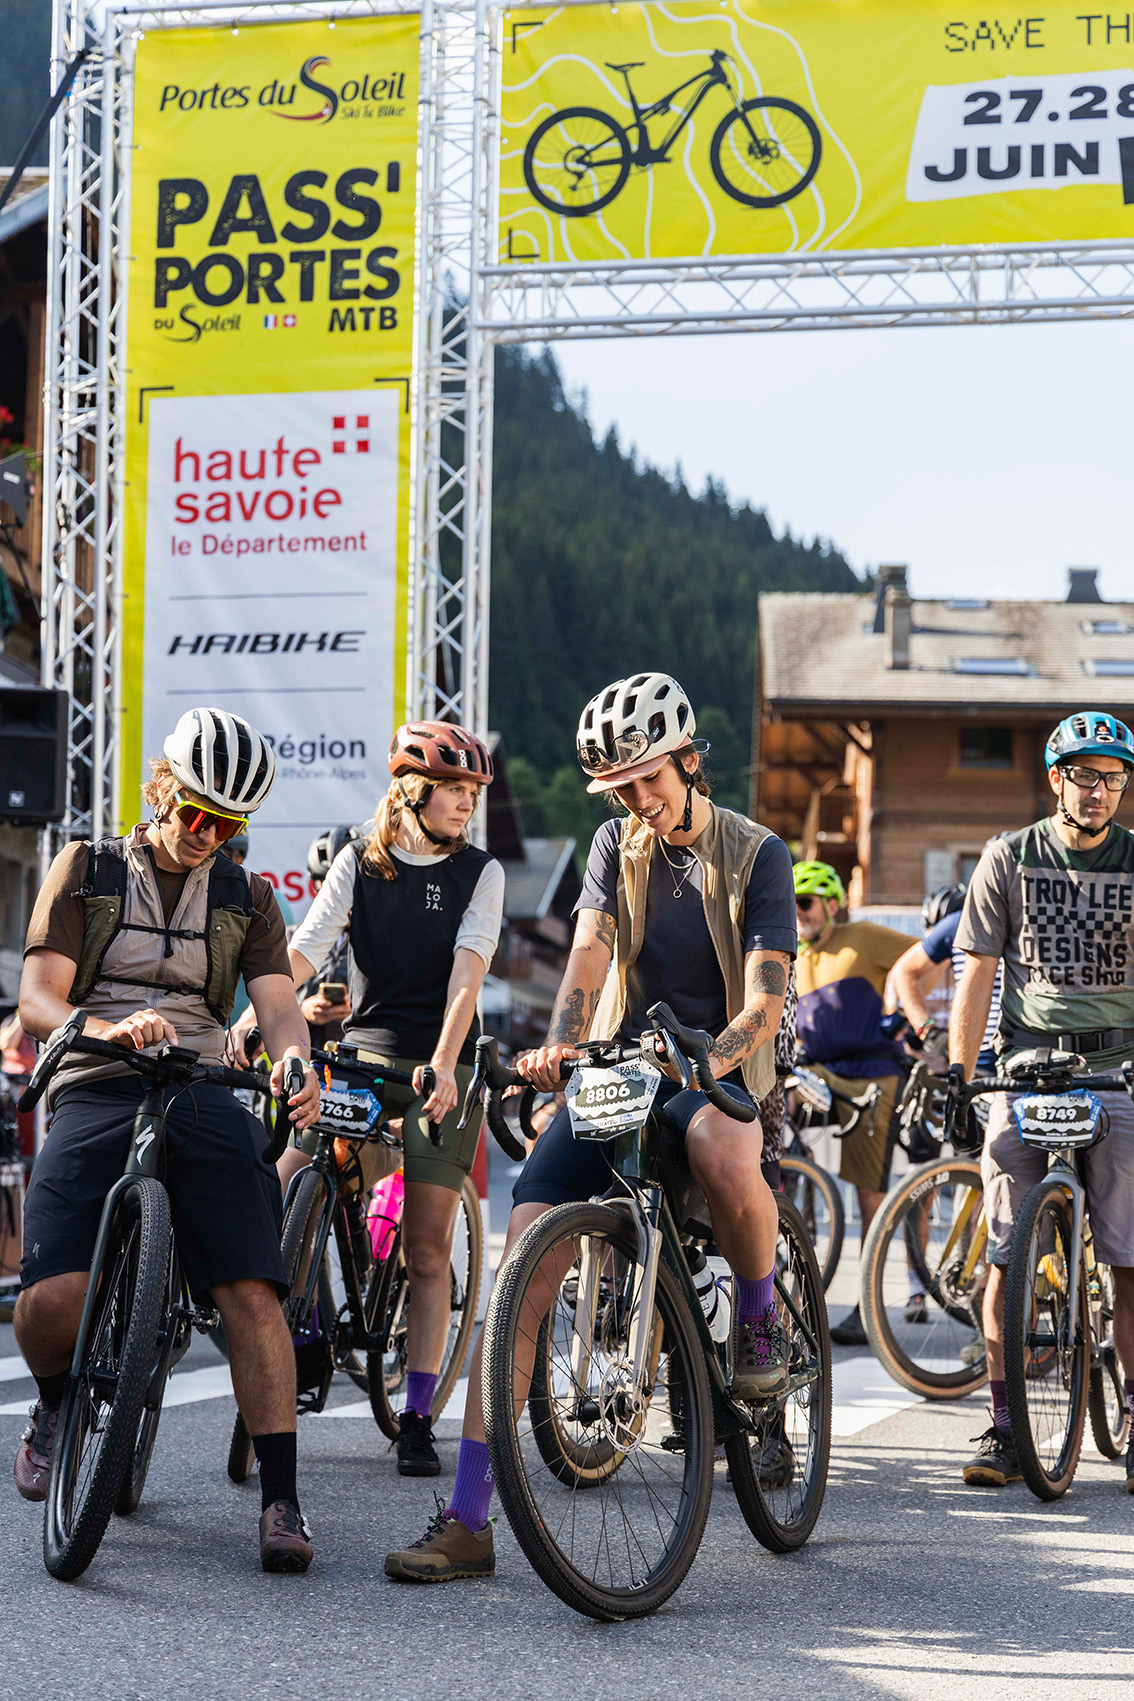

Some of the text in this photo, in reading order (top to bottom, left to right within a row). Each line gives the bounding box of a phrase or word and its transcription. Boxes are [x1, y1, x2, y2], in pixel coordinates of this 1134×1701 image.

[945, 13, 1134, 52] SAVE TH
[159, 55, 406, 124] Portes du Soleil
[924, 141, 1100, 182] JUIN
[157, 162, 400, 248] PASS'
[154, 246, 400, 308] PORTES
[154, 303, 242, 343] DU Soleil
[328, 306, 398, 332] MTB
[174, 434, 322, 483] haute
[174, 486, 342, 524] savoie
[171, 531, 367, 558] le Département
[168, 630, 367, 656] HAIBIKE
[426, 883, 441, 893] MA
[426, 892, 441, 902] LO
[1023, 875, 1133, 911] TROY LEE
[1023, 936, 1128, 969] DESIGNS
[585, 1083, 631, 1104] 8806
[1036, 1108, 1077, 1120] 8749
